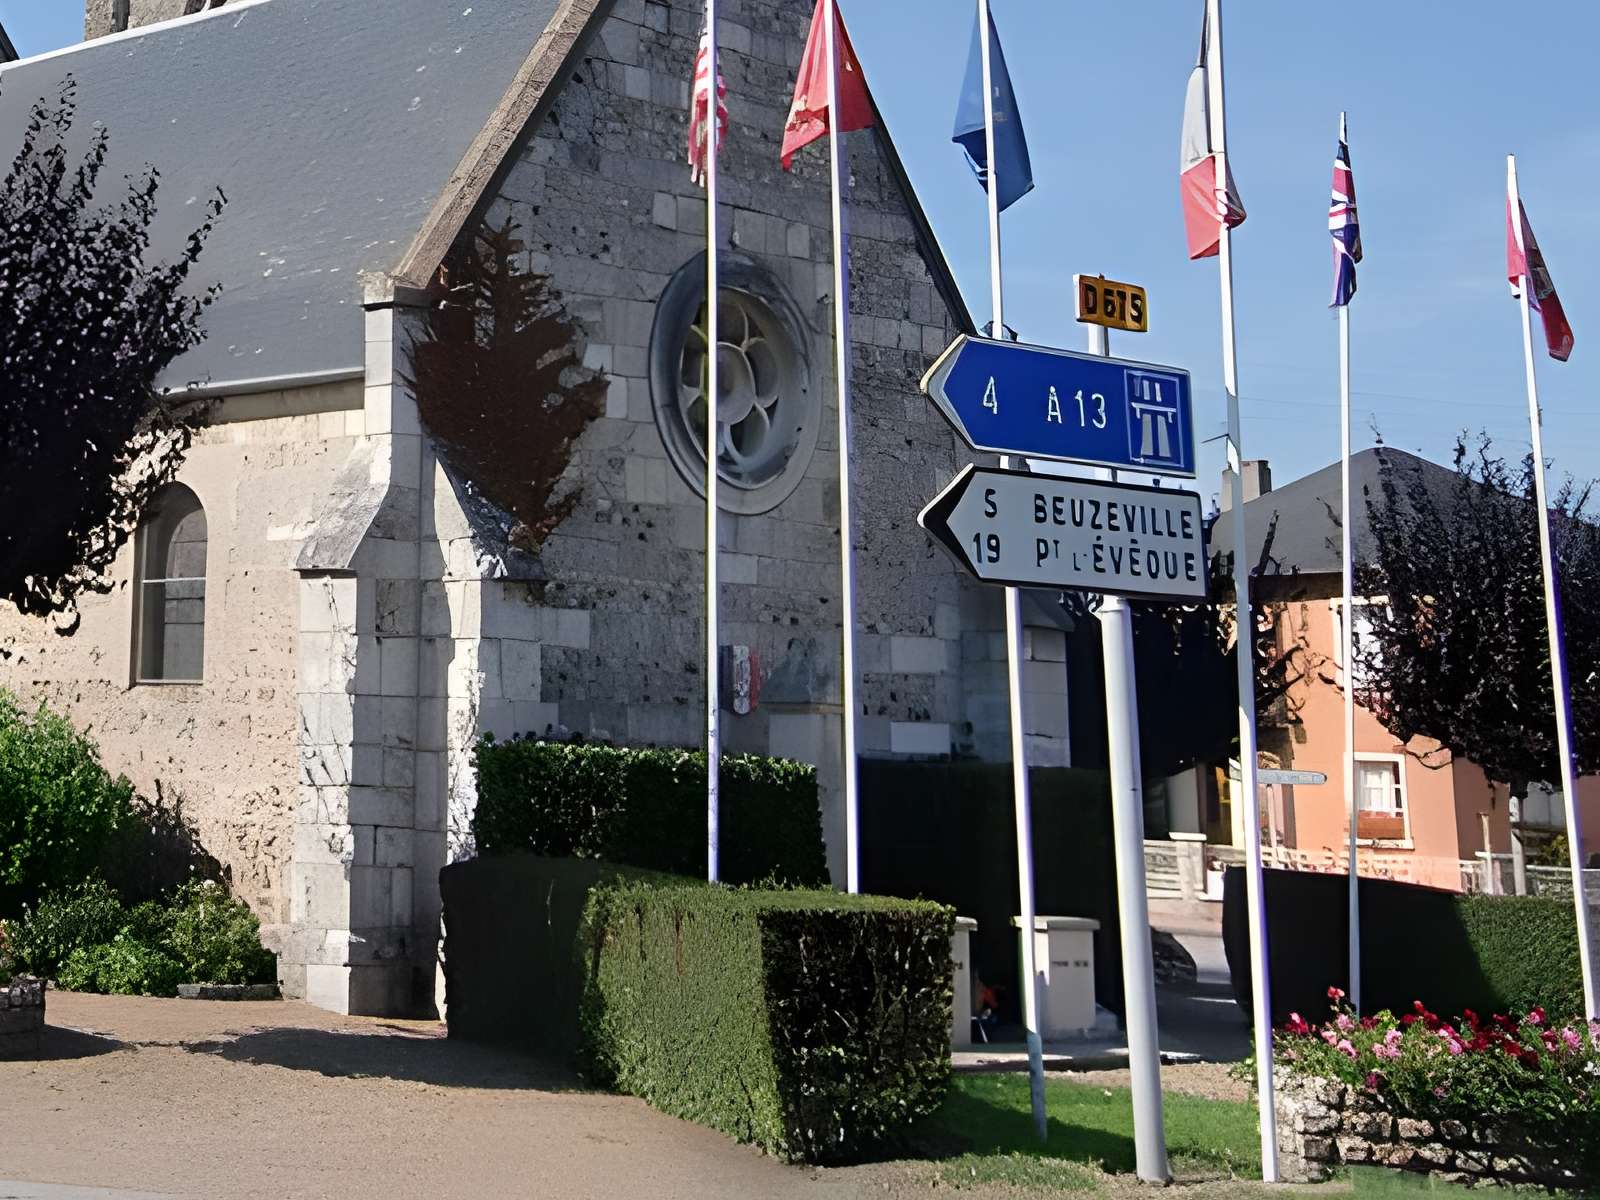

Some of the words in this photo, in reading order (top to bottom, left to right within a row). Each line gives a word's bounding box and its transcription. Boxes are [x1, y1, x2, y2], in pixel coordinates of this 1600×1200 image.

[983, 376, 998, 415] 4
[1034, 493, 1193, 540] BEUZEVILLE
[973, 532, 1000, 563] 19
